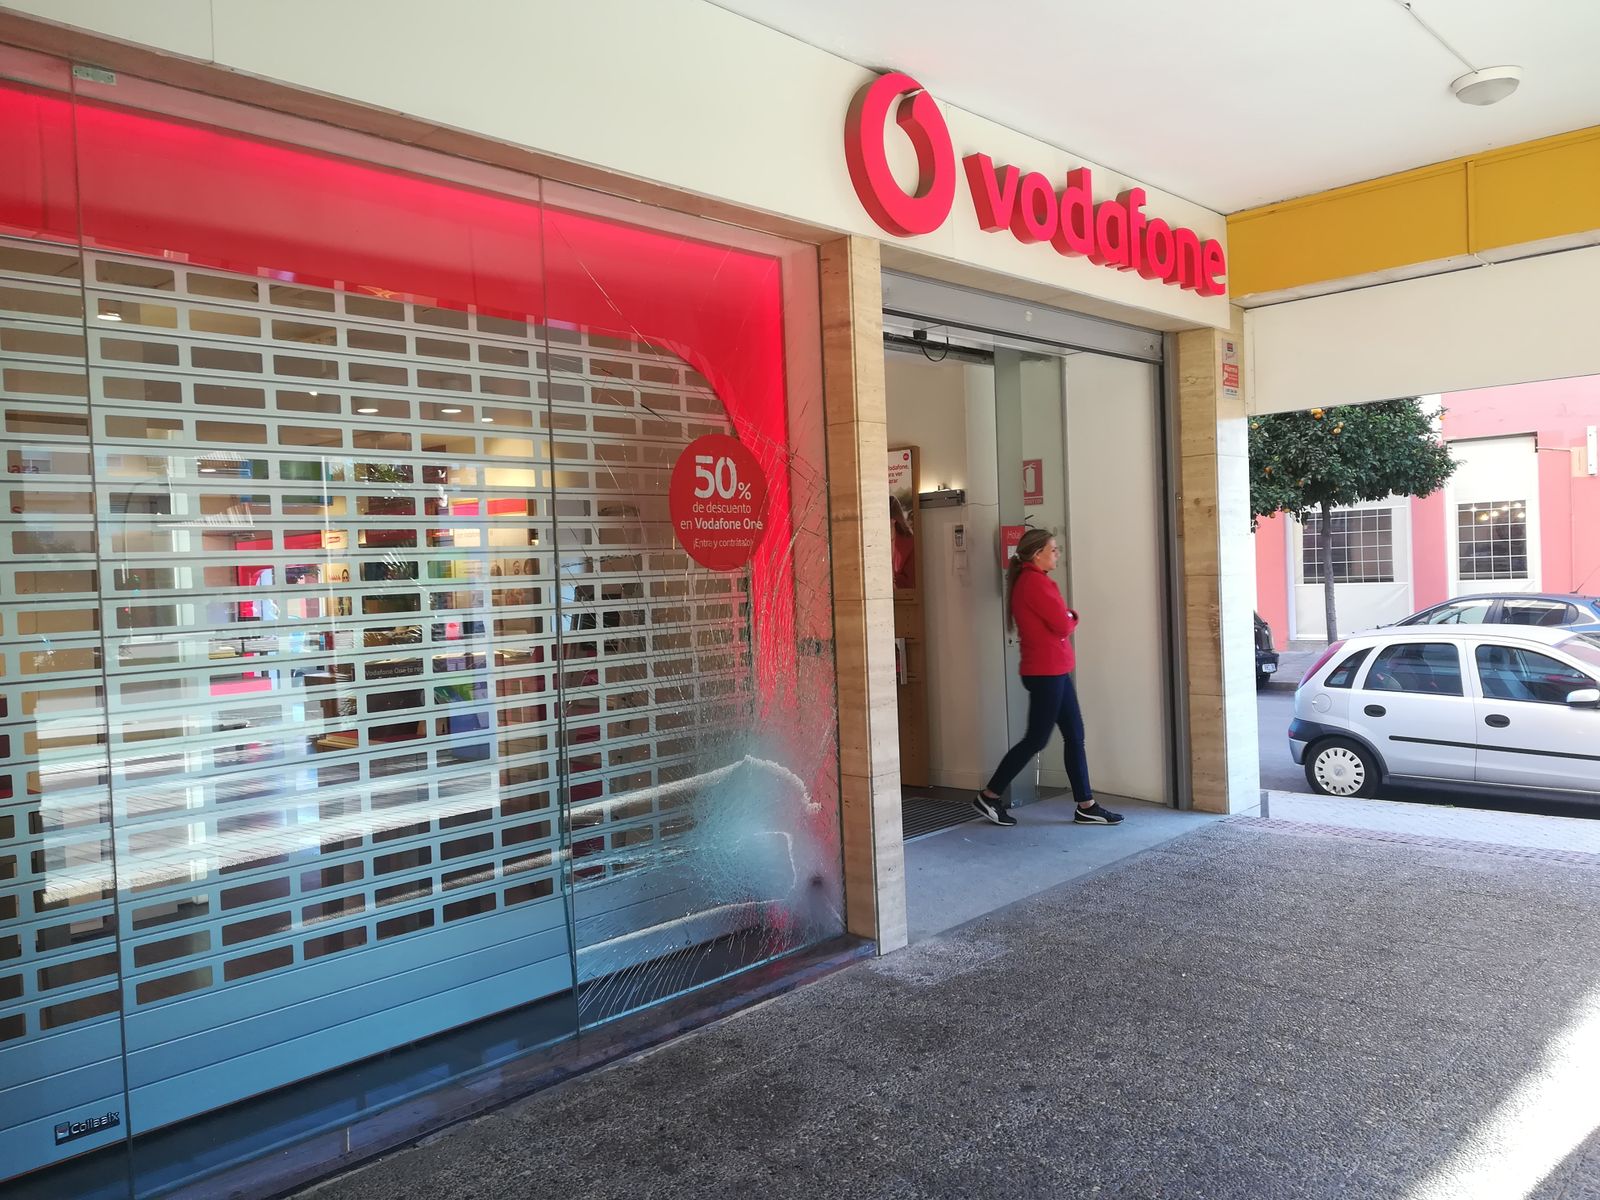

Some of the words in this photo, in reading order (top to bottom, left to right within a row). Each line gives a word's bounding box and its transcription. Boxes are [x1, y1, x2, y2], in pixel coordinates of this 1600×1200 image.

[962, 152, 1226, 298] vodafone
[694, 455, 752, 500] 50%
[692, 502, 705, 514] de
[706, 502, 752, 514] descuento
[680, 520, 693, 530] en
[694, 517, 741, 530] Vodafone
[743, 517, 763, 530] One
